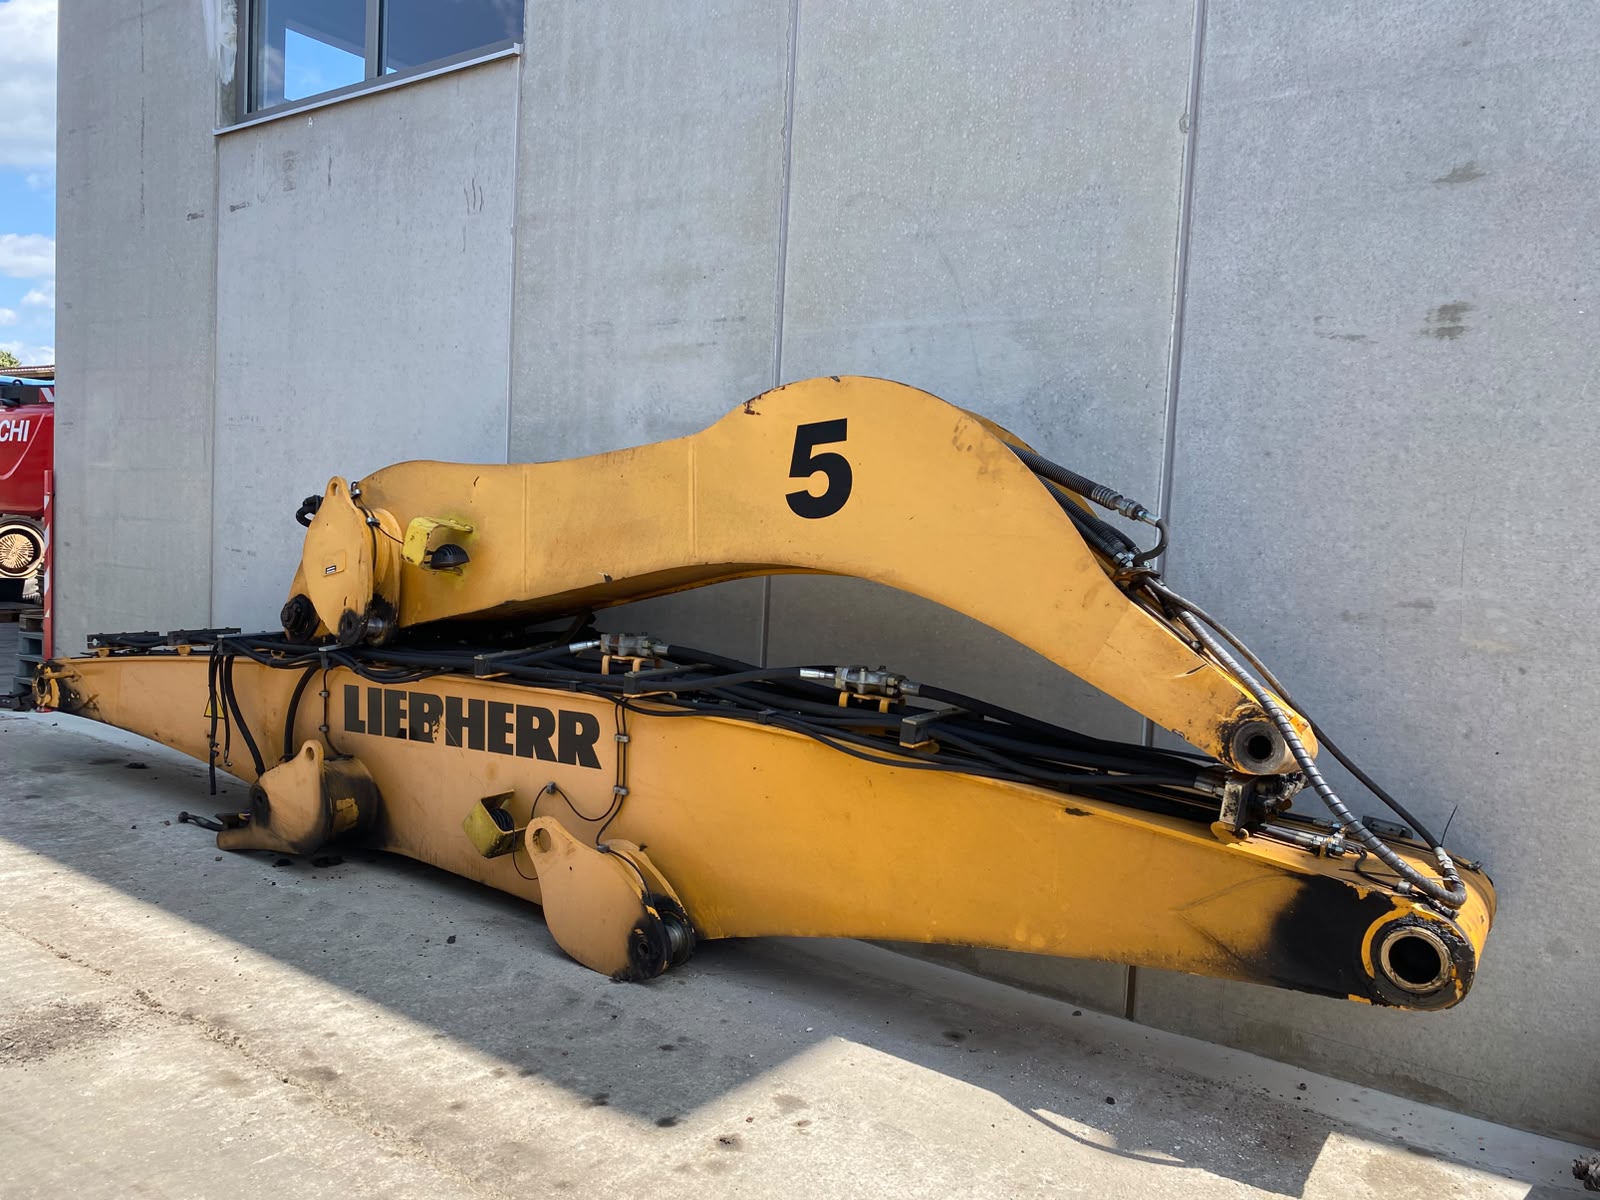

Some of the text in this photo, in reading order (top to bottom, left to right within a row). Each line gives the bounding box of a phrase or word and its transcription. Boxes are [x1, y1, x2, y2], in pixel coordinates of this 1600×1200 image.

[0, 419, 30, 442] CHI
[785, 418, 852, 519] 5
[344, 685, 602, 769] LIEBHERR
